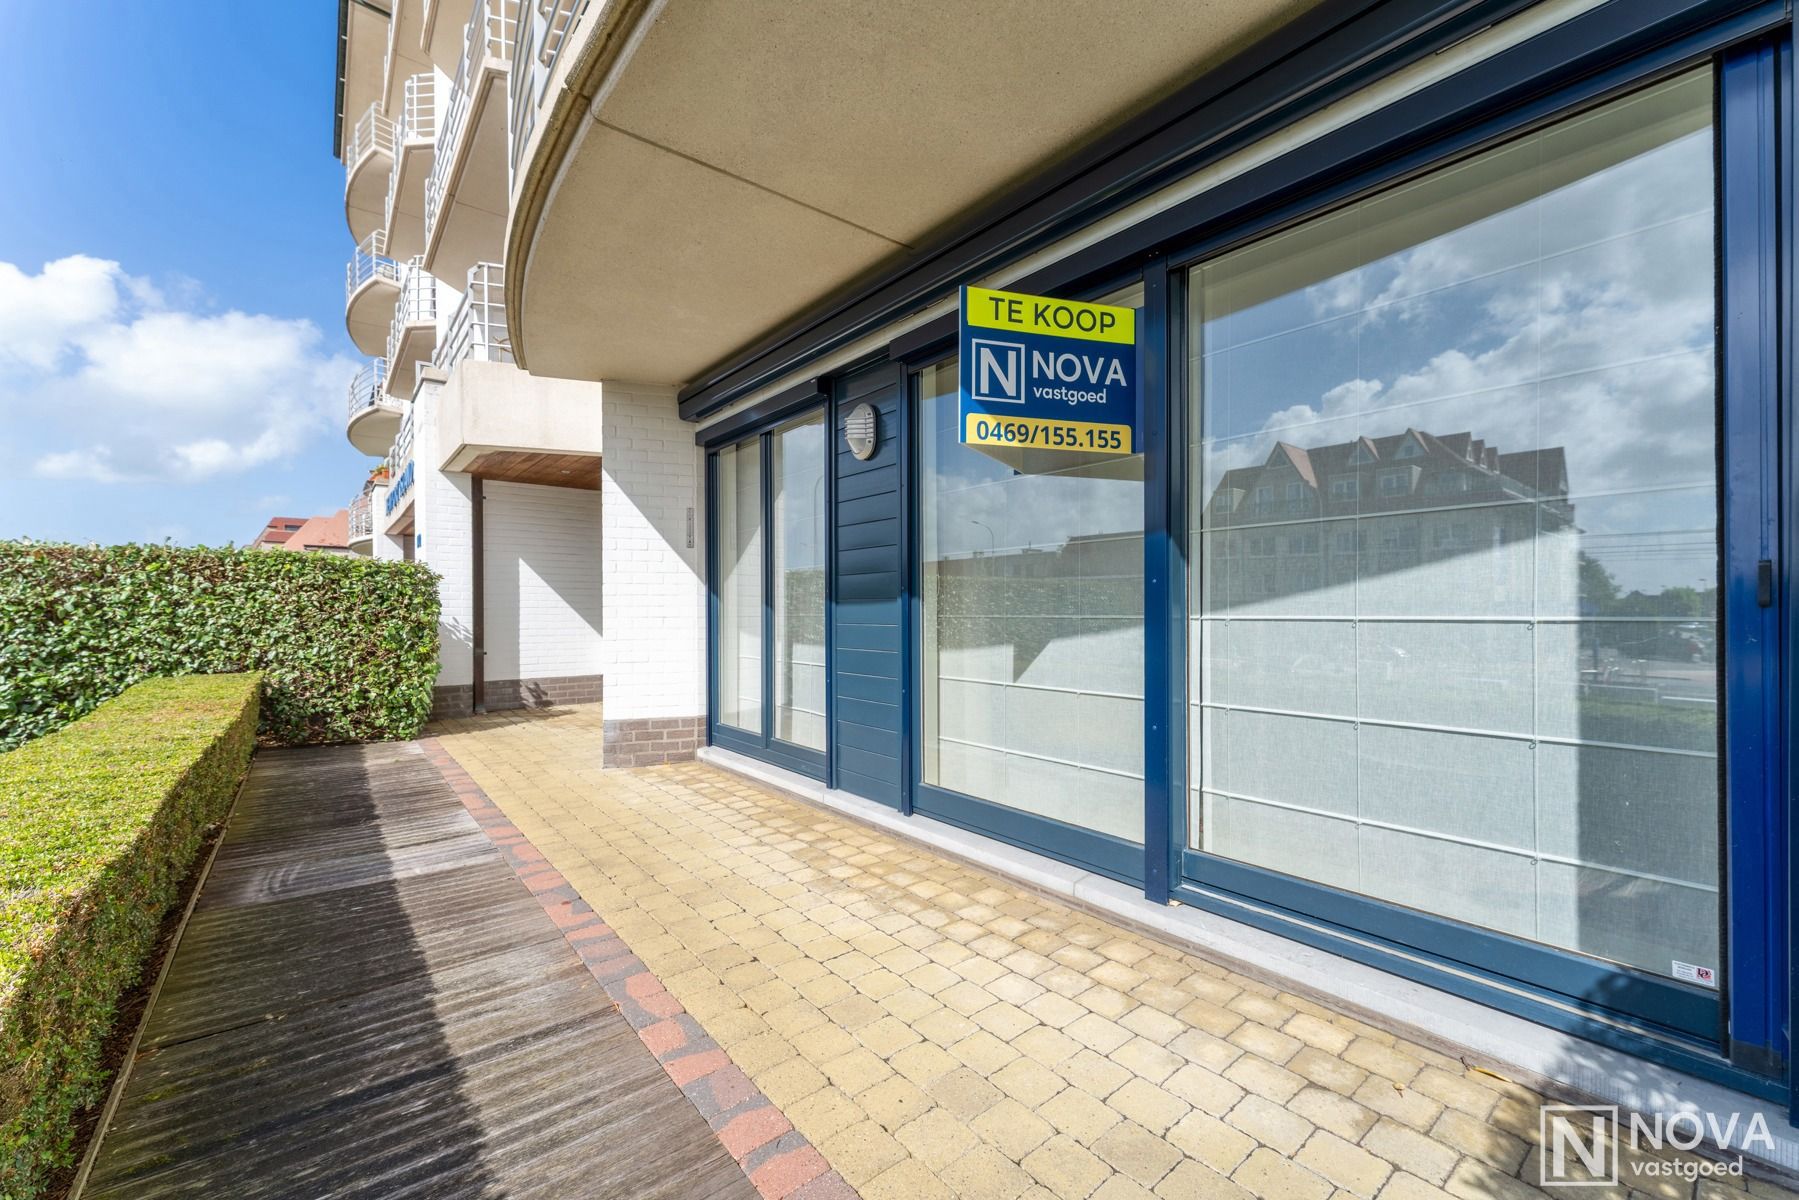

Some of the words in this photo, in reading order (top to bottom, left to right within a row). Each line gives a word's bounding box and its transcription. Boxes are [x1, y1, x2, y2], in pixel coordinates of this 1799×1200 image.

[988, 296, 1023, 324] TE
[1034, 303, 1116, 334] KOOP
[980, 347, 1017, 397] N
[1032, 350, 1128, 387] NOVA
[1033, 386, 1107, 406] vastgoed
[976, 420, 1122, 450] 0469/155.155
